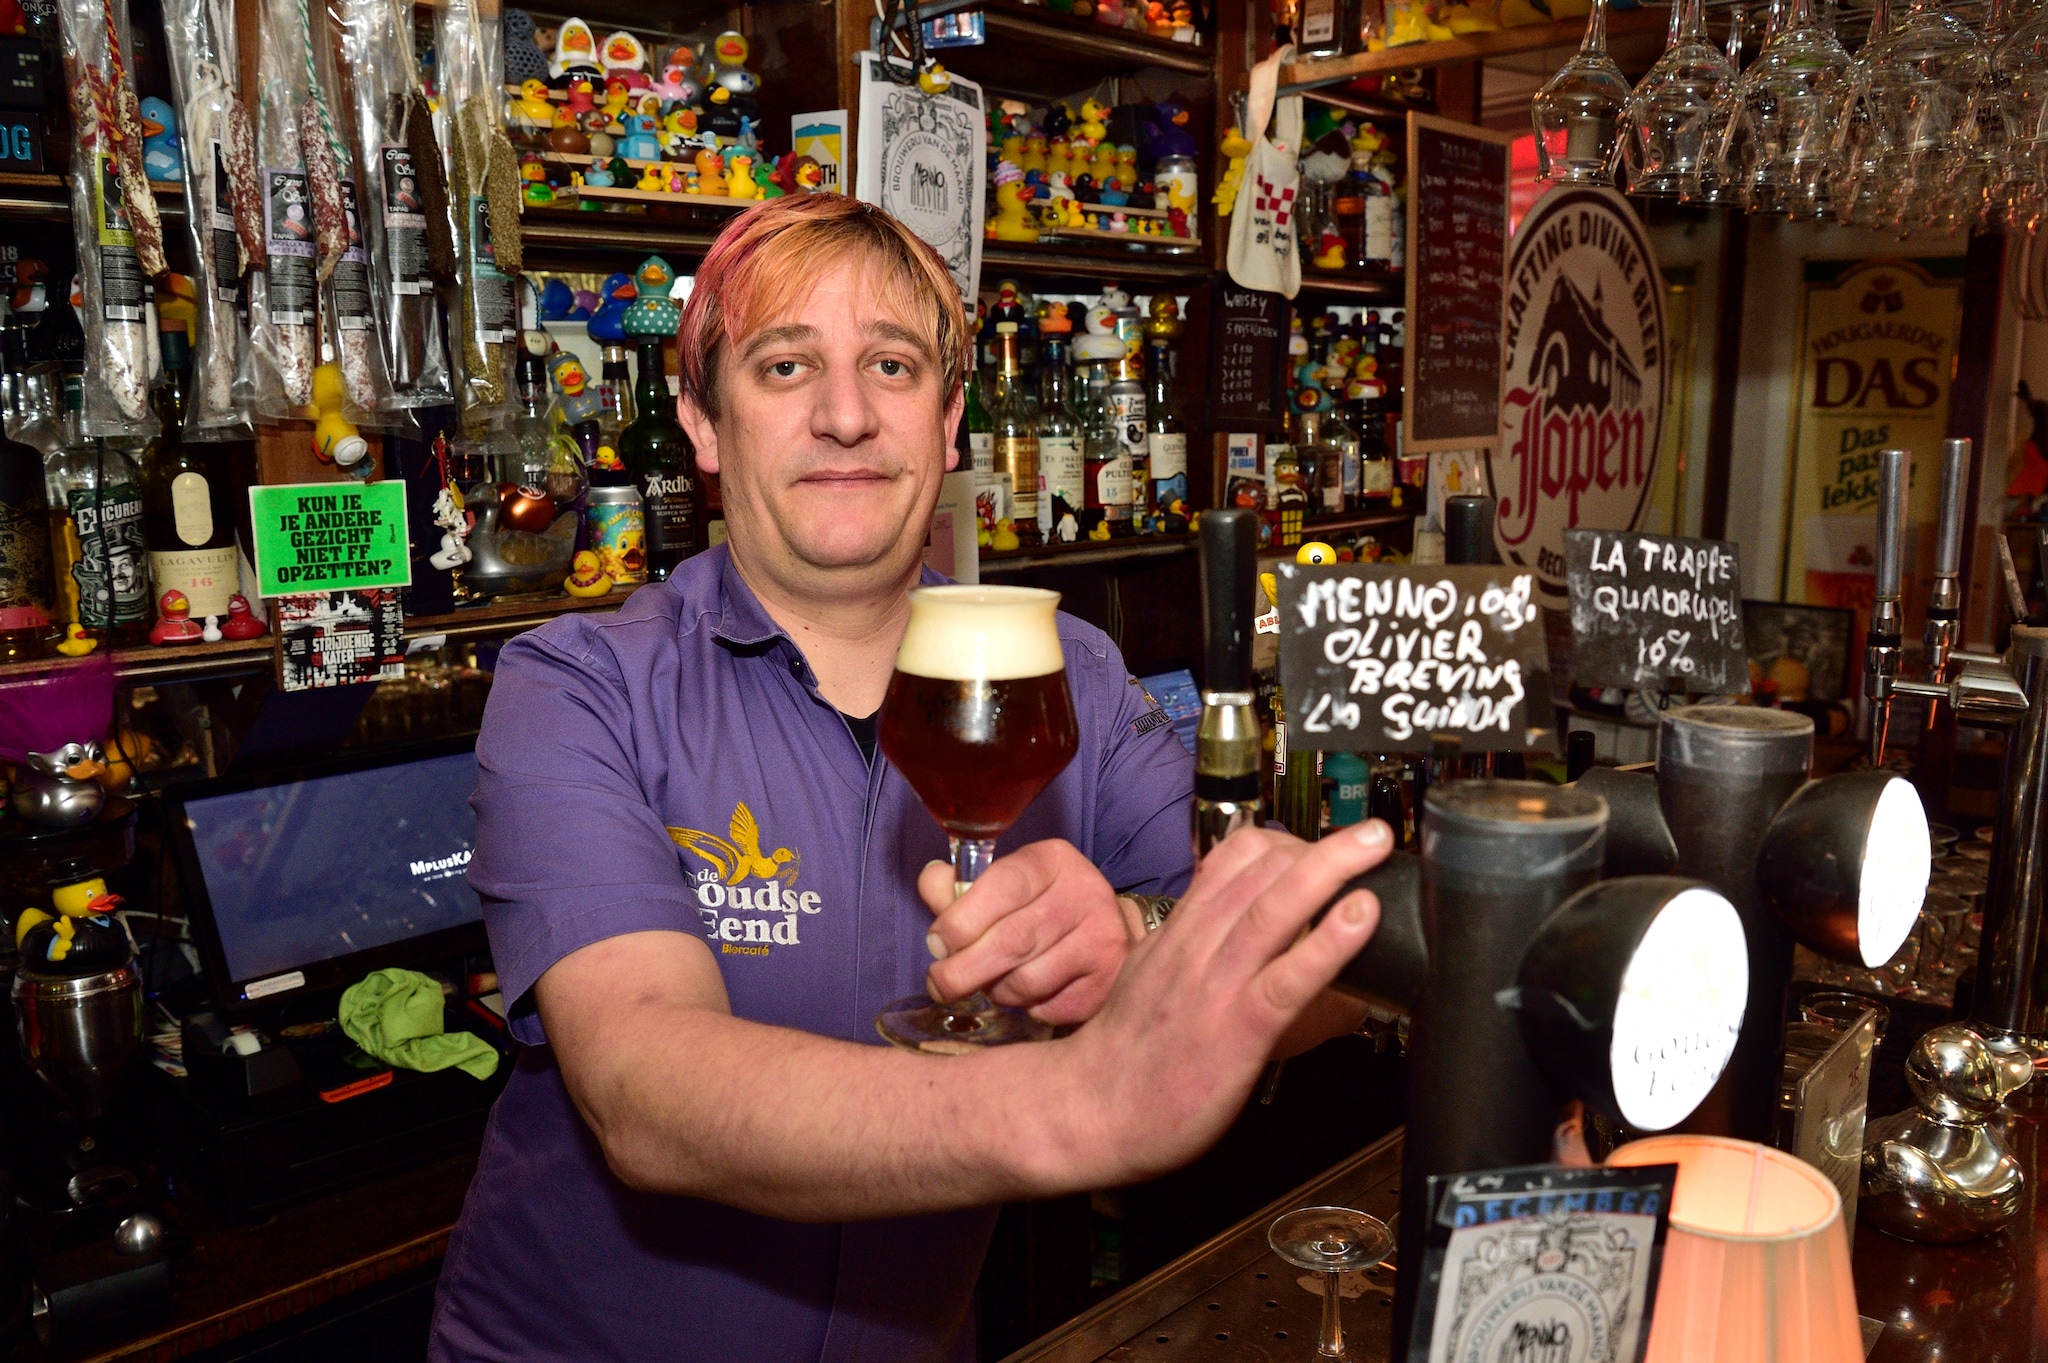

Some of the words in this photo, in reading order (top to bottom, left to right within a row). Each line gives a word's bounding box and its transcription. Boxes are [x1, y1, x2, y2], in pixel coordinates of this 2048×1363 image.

[22, 2, 57, 14] ONKEY
[921, 134, 940, 150] VAN
[940, 143, 953, 160] DE
[950, 159, 964, 205] MAAND
[1578, 210, 1642, 283] DIVINE
[1639, 277, 1657, 370] BEER
[1811, 357, 1941, 410] DAS
[1839, 423, 1891, 456] Das
[1497, 385, 1645, 545] Jopen
[102, 498, 115, 507] HE
[297, 495, 337, 513] KUN
[342, 494, 362, 511] JE
[1106, 488, 1117, 497] 15
[280, 515, 299, 532] JE
[305, 510, 382, 530] ANDERE
[672, 516, 687, 524] TEN
[290, 527, 374, 548] GEZICHT
[160, 553, 234, 566] LAGAVULIN
[296, 546, 342, 565] NIET
[347, 544, 371, 560] FF
[1590, 537, 1627, 578] LA
[1638, 538, 1733, 590] TRAPPE
[191, 577, 213, 587] 16
[277, 559, 392, 584] OPZETTEN?
[1298, 576, 1458, 629] MENNO
[1593, 585, 1737, 641] QUADRUPEL
[1258, 615, 1279, 629] ABL
[313, 633, 375, 653] STRIJDENDE
[322, 649, 355, 666] KATER
[410, 849, 475, 876] MPLUSKA
[697, 869, 719, 883] de
[698, 880, 822, 915] Oudse
[1453, 1190, 1661, 1229] DECEMBER
[1538, 1278, 1568, 1291] VAN
[1568, 1282, 1586, 1301] DE
